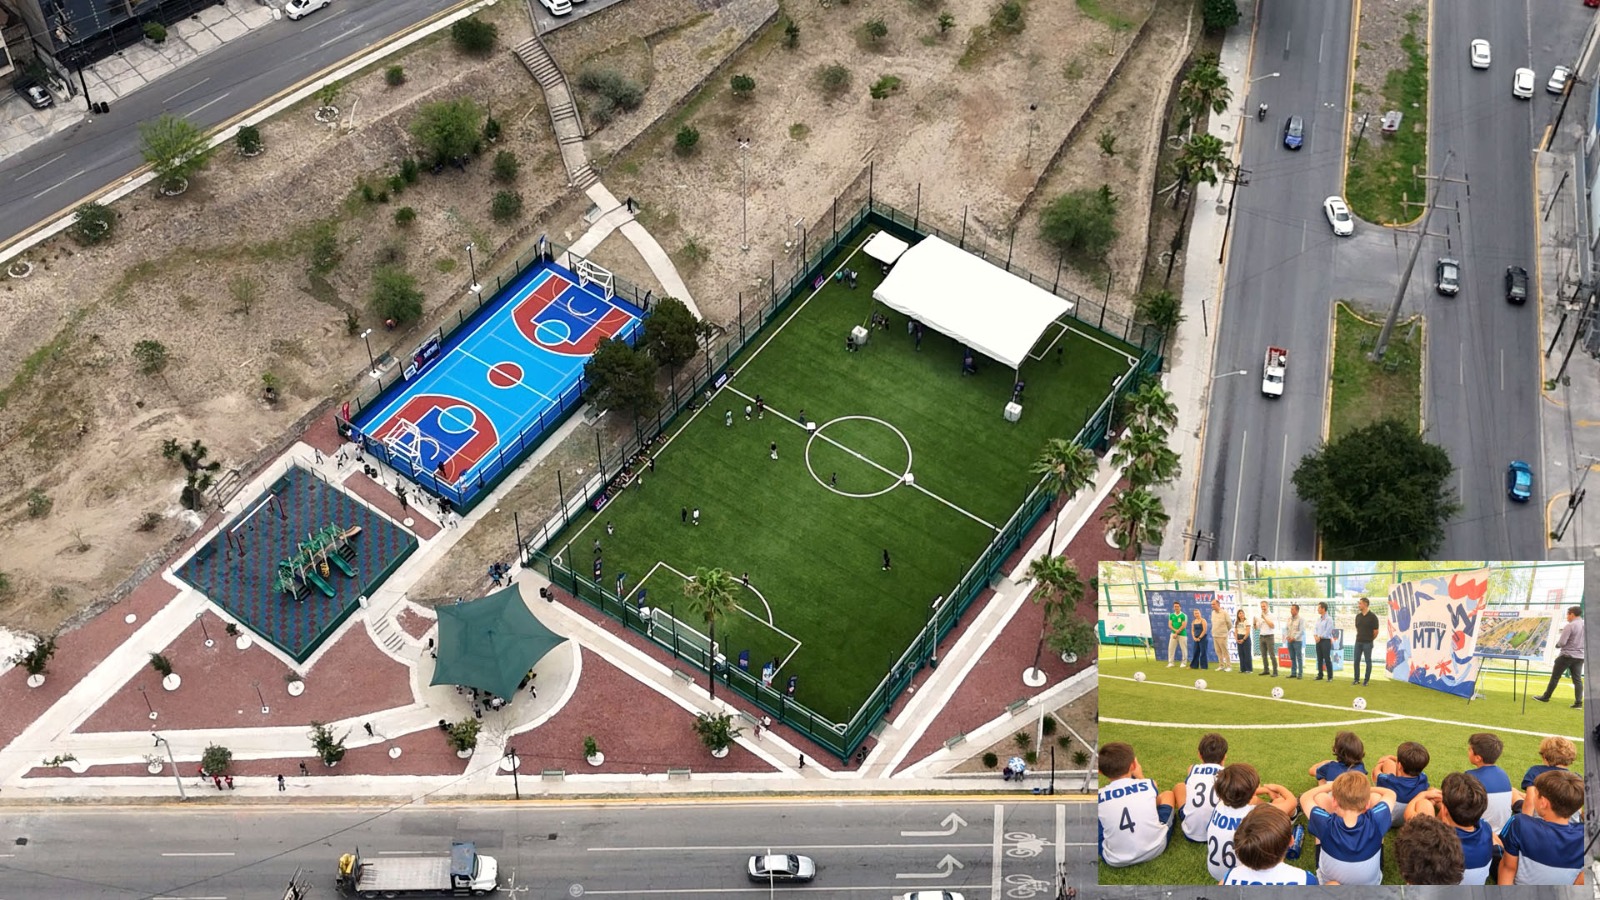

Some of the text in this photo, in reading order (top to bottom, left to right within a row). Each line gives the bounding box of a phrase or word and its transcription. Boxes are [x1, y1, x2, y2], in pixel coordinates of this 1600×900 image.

[1193, 592, 1212, 601] MTY
[1413, 628, 1446, 650] MTY
[1193, 766, 1221, 776] LION
[1098, 782, 1149, 804] LIONS
[1119, 806, 1136, 833] 4
[1212, 810, 1242, 831] LION
[1208, 835, 1237, 868] 26
